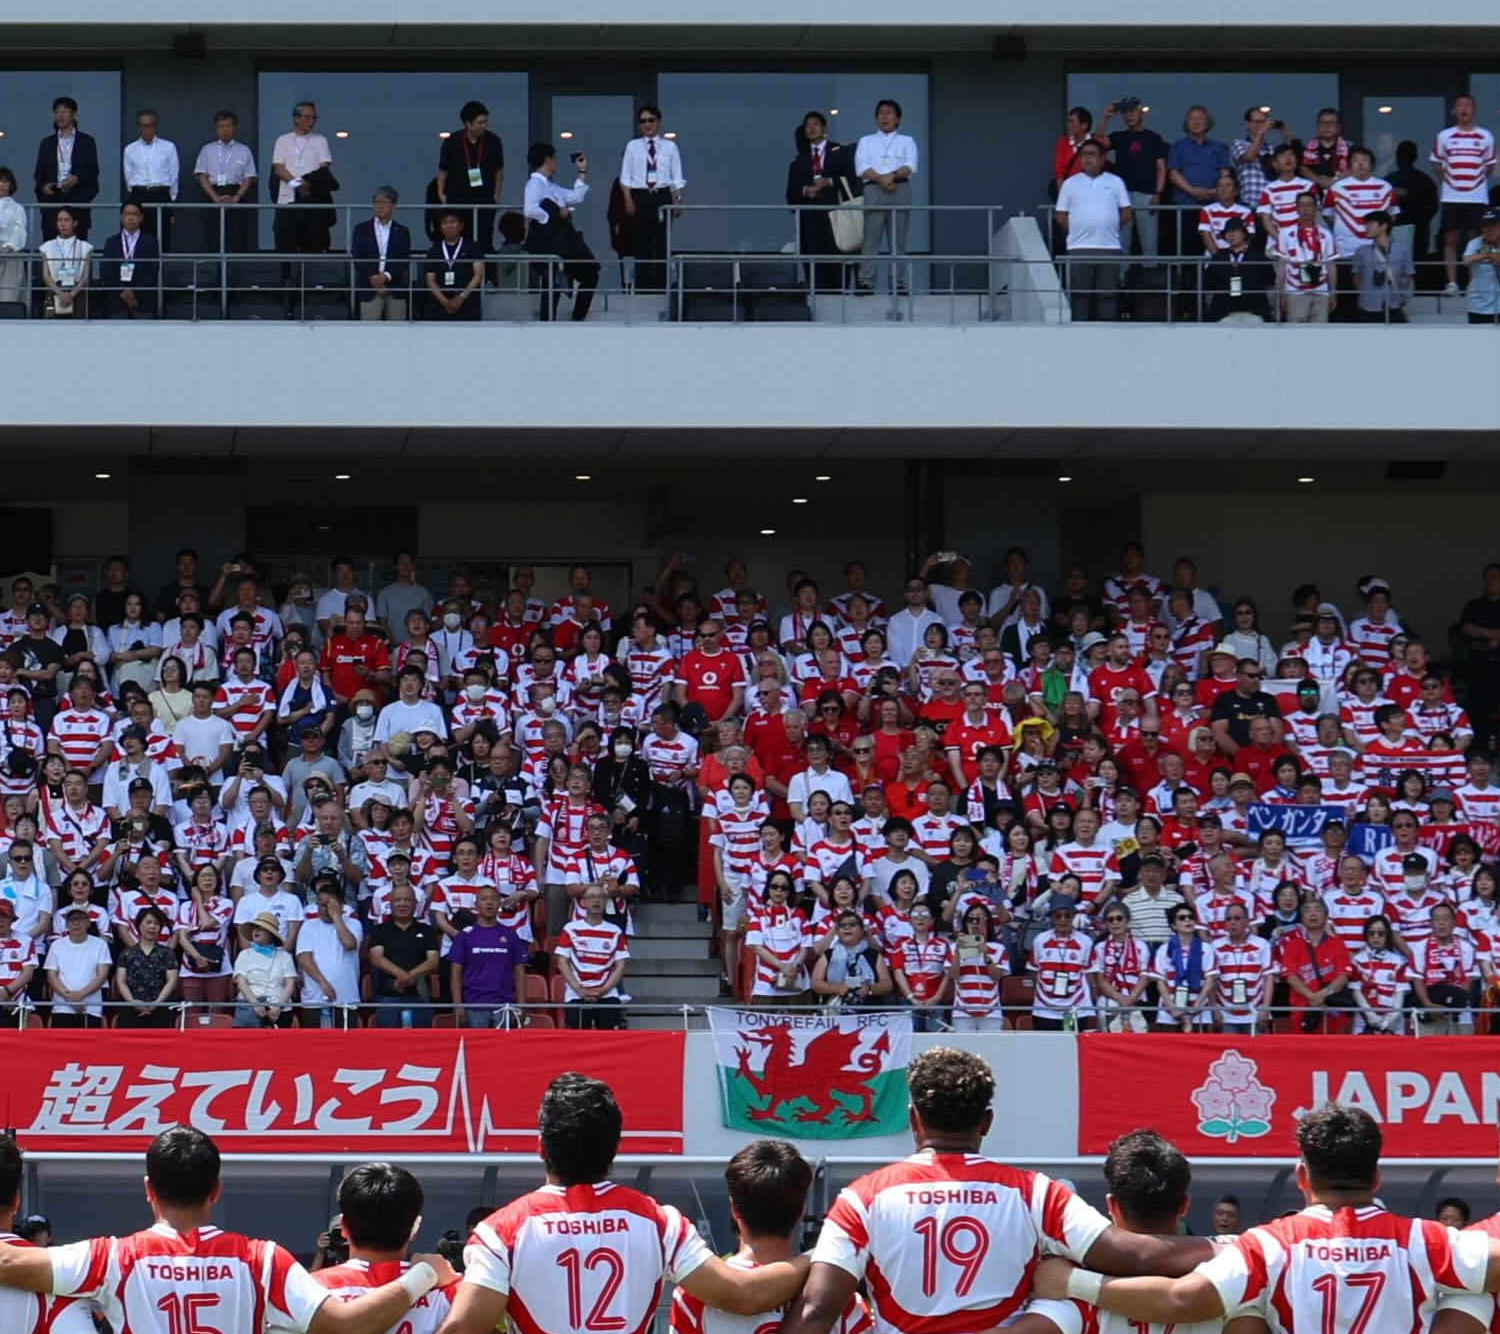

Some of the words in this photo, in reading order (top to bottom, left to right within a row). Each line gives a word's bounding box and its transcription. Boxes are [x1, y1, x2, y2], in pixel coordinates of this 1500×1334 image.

[856, 1014, 889, 1028] RFC
[29, 1062, 442, 1132] 超えていこう
[904, 1190, 998, 1206] TOSHIBA
[543, 1217, 629, 1236] TOSHIBA
[913, 1216, 990, 1299] 19
[1306, 1244, 1391, 1263] TOSHIBA
[147, 1262, 233, 1282] TOSHIBA
[557, 1247, 627, 1332] 12
